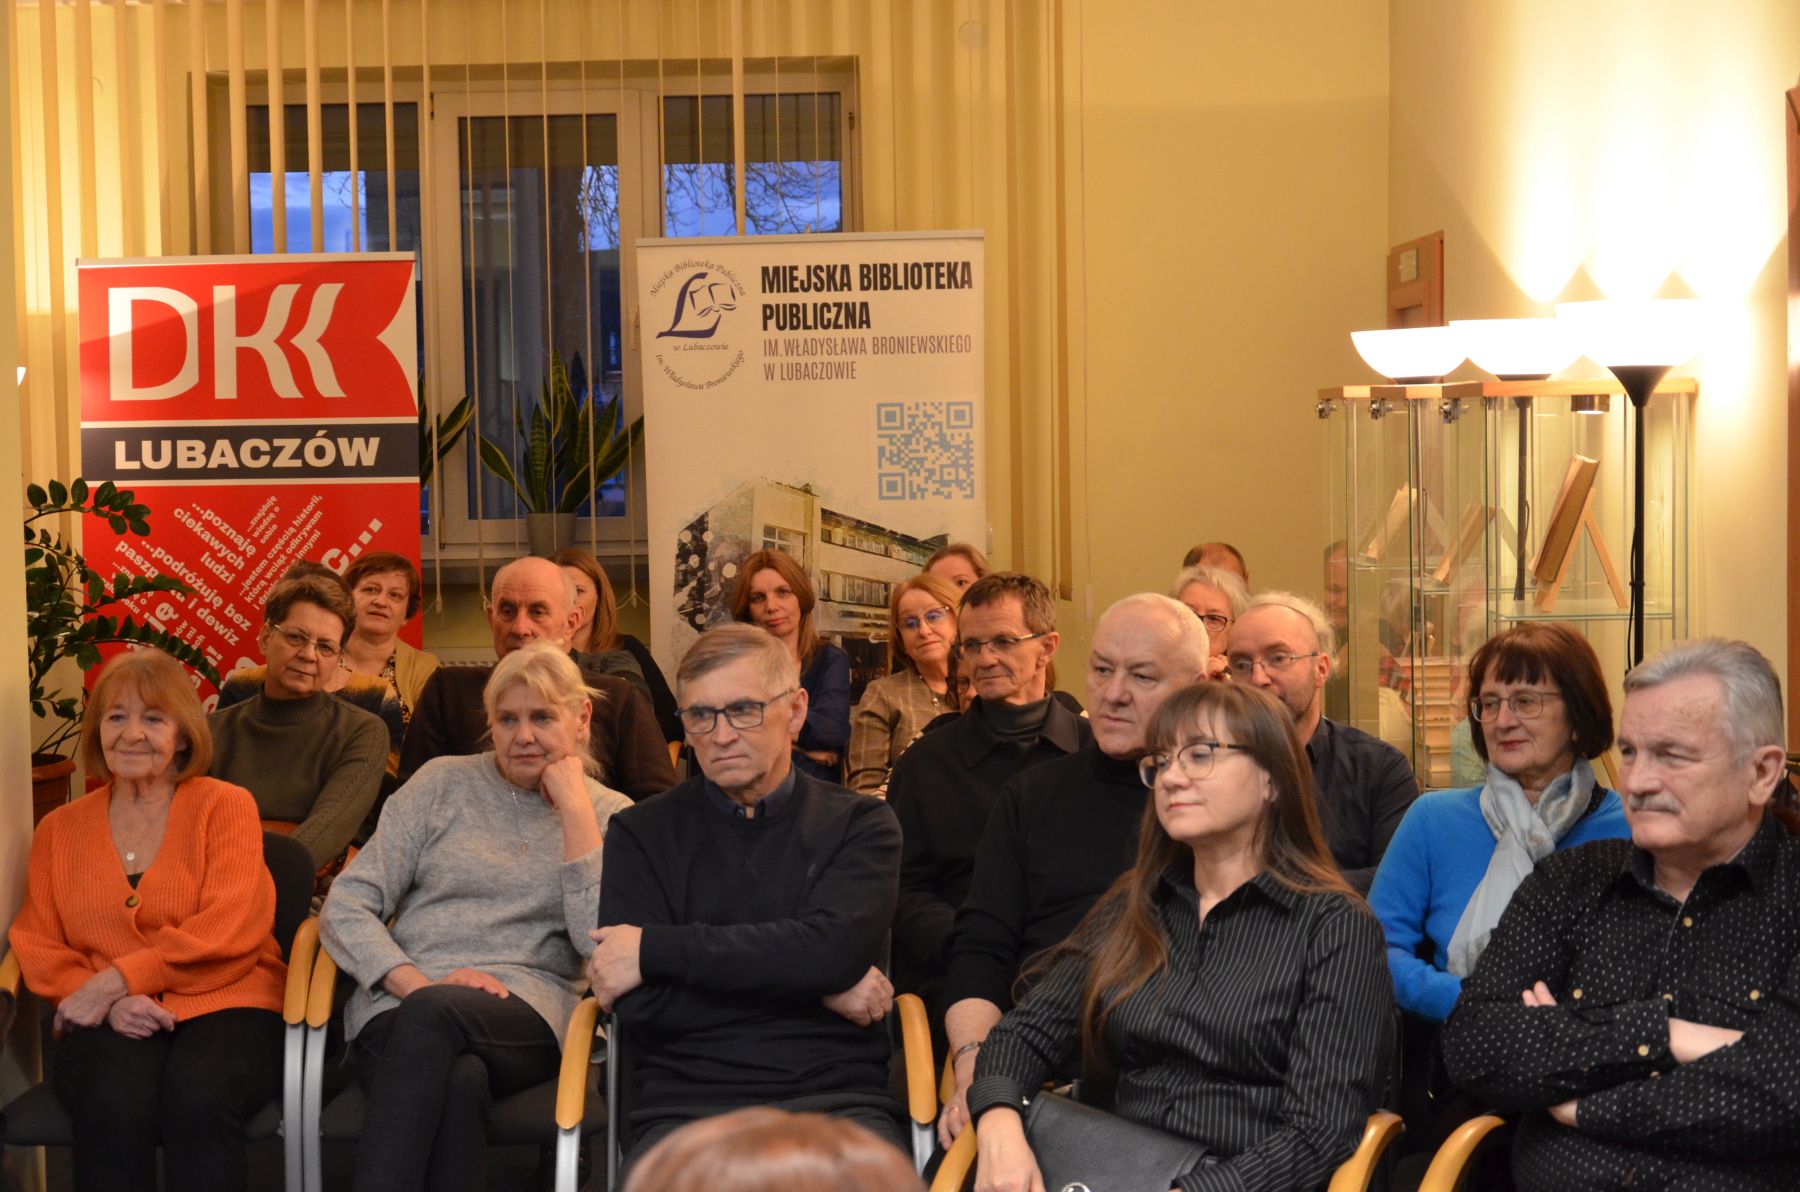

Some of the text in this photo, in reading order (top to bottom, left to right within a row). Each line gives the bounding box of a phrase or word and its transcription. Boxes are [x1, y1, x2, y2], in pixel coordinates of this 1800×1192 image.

[673, 259, 715, 273] Biblioteka
[716, 264, 746, 297] Publiczna
[761, 261, 973, 294] MIEJSKA BIBLIOTEKA
[762, 301, 871, 331] PUBLICZNA
[682, 342, 729, 352] Lubaczowie
[872, 334, 972, 355] BRONIEWSKIEGO
[763, 361, 857, 381] W LUBACZOWIE
[114, 430, 381, 470] LUBACZÓW
[173, 508, 245, 570] ciekawych
[192, 502, 256, 558] ...poznaję
[200, 551, 236, 584] ludzi
[244, 579, 268, 603] którą
[285, 510, 323, 554] odkrywam
[141, 540, 223, 610] ...podróżuję
[223, 603, 252, 631] bez
[187, 598, 198, 609] i
[196, 607, 240, 646] dewiz
